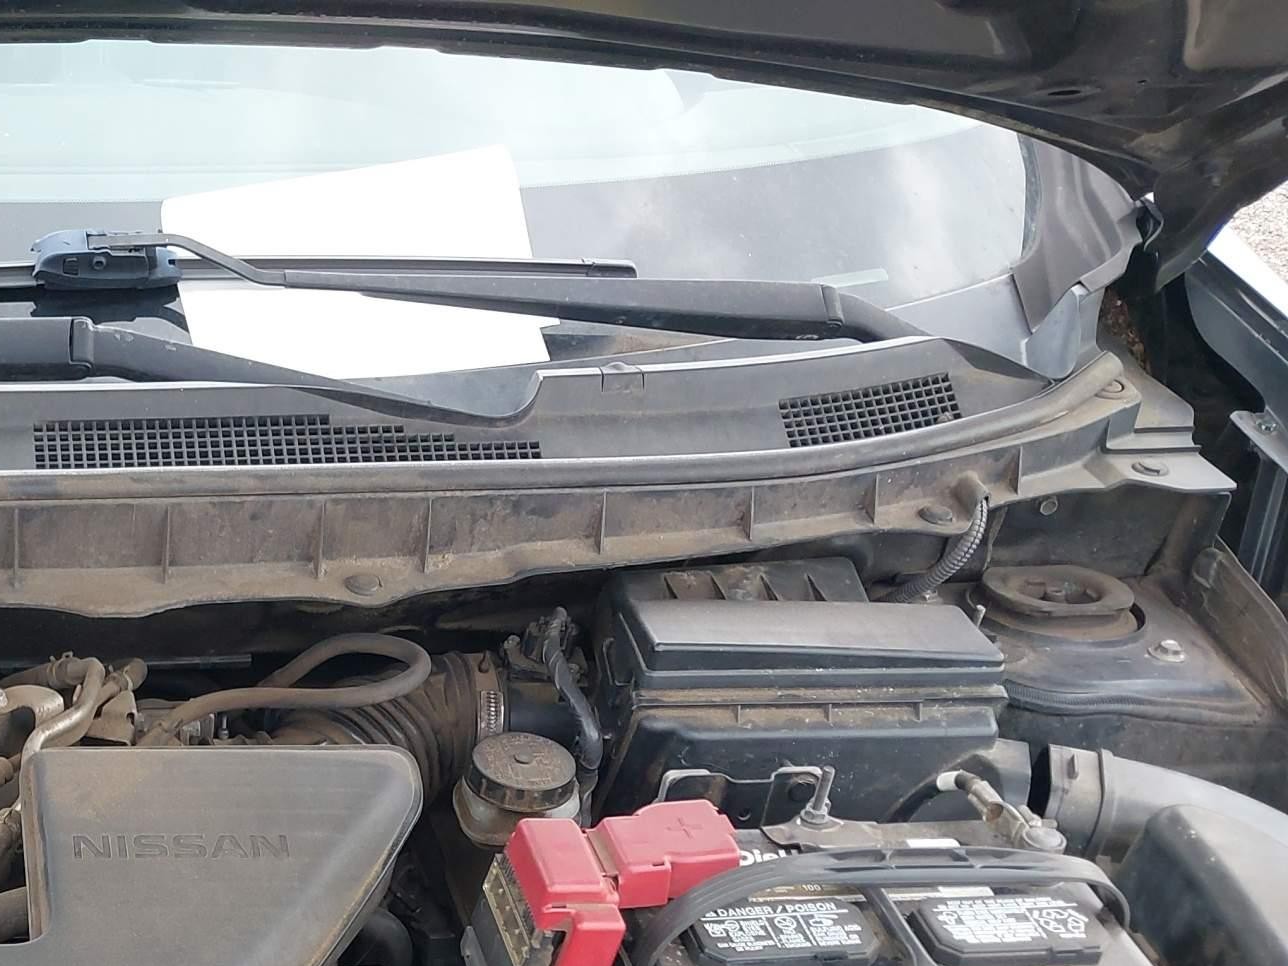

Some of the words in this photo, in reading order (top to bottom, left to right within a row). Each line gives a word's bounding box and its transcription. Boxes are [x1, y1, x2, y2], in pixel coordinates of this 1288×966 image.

[72, 833, 290, 859] NISSAN
[718, 906, 774, 918] DANGER
[787, 902, 837, 914] POISON
